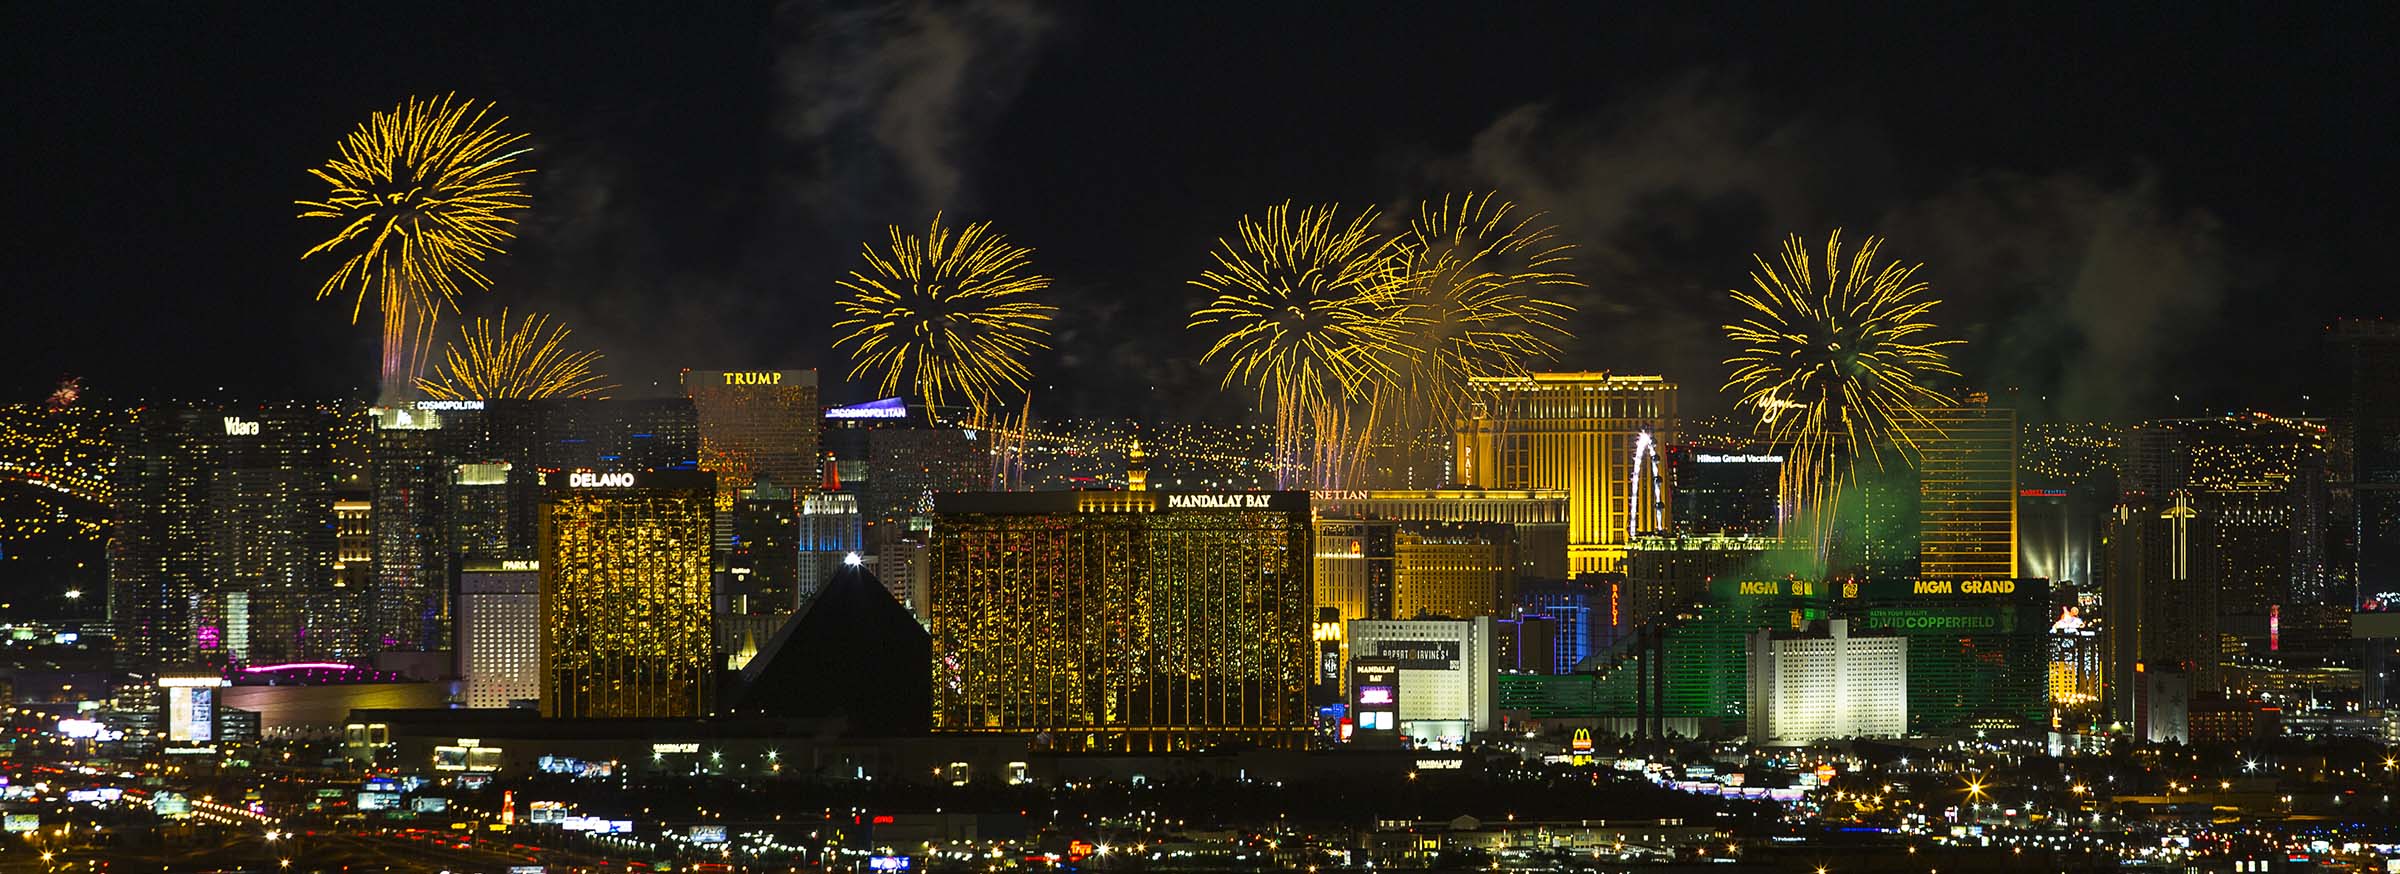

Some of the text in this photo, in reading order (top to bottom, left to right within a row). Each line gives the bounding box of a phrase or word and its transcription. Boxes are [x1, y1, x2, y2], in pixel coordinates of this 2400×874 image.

[723, 372, 782, 385] TRUMP
[417, 401, 484, 410] COSMOPOLITAN
[839, 408, 905, 418] COSMOPOLITAN
[224, 417, 259, 436] Vdara
[1696, 455, 1783, 463] Hilton Grand Vacations
[570, 473, 634, 487] DELANO
[1168, 495, 1271, 507] MANDALAY BAY
[502, 561, 528, 570] PARK
[1740, 581, 1778, 595] MGM
[1914, 581, 2015, 593] MGM GRAND
